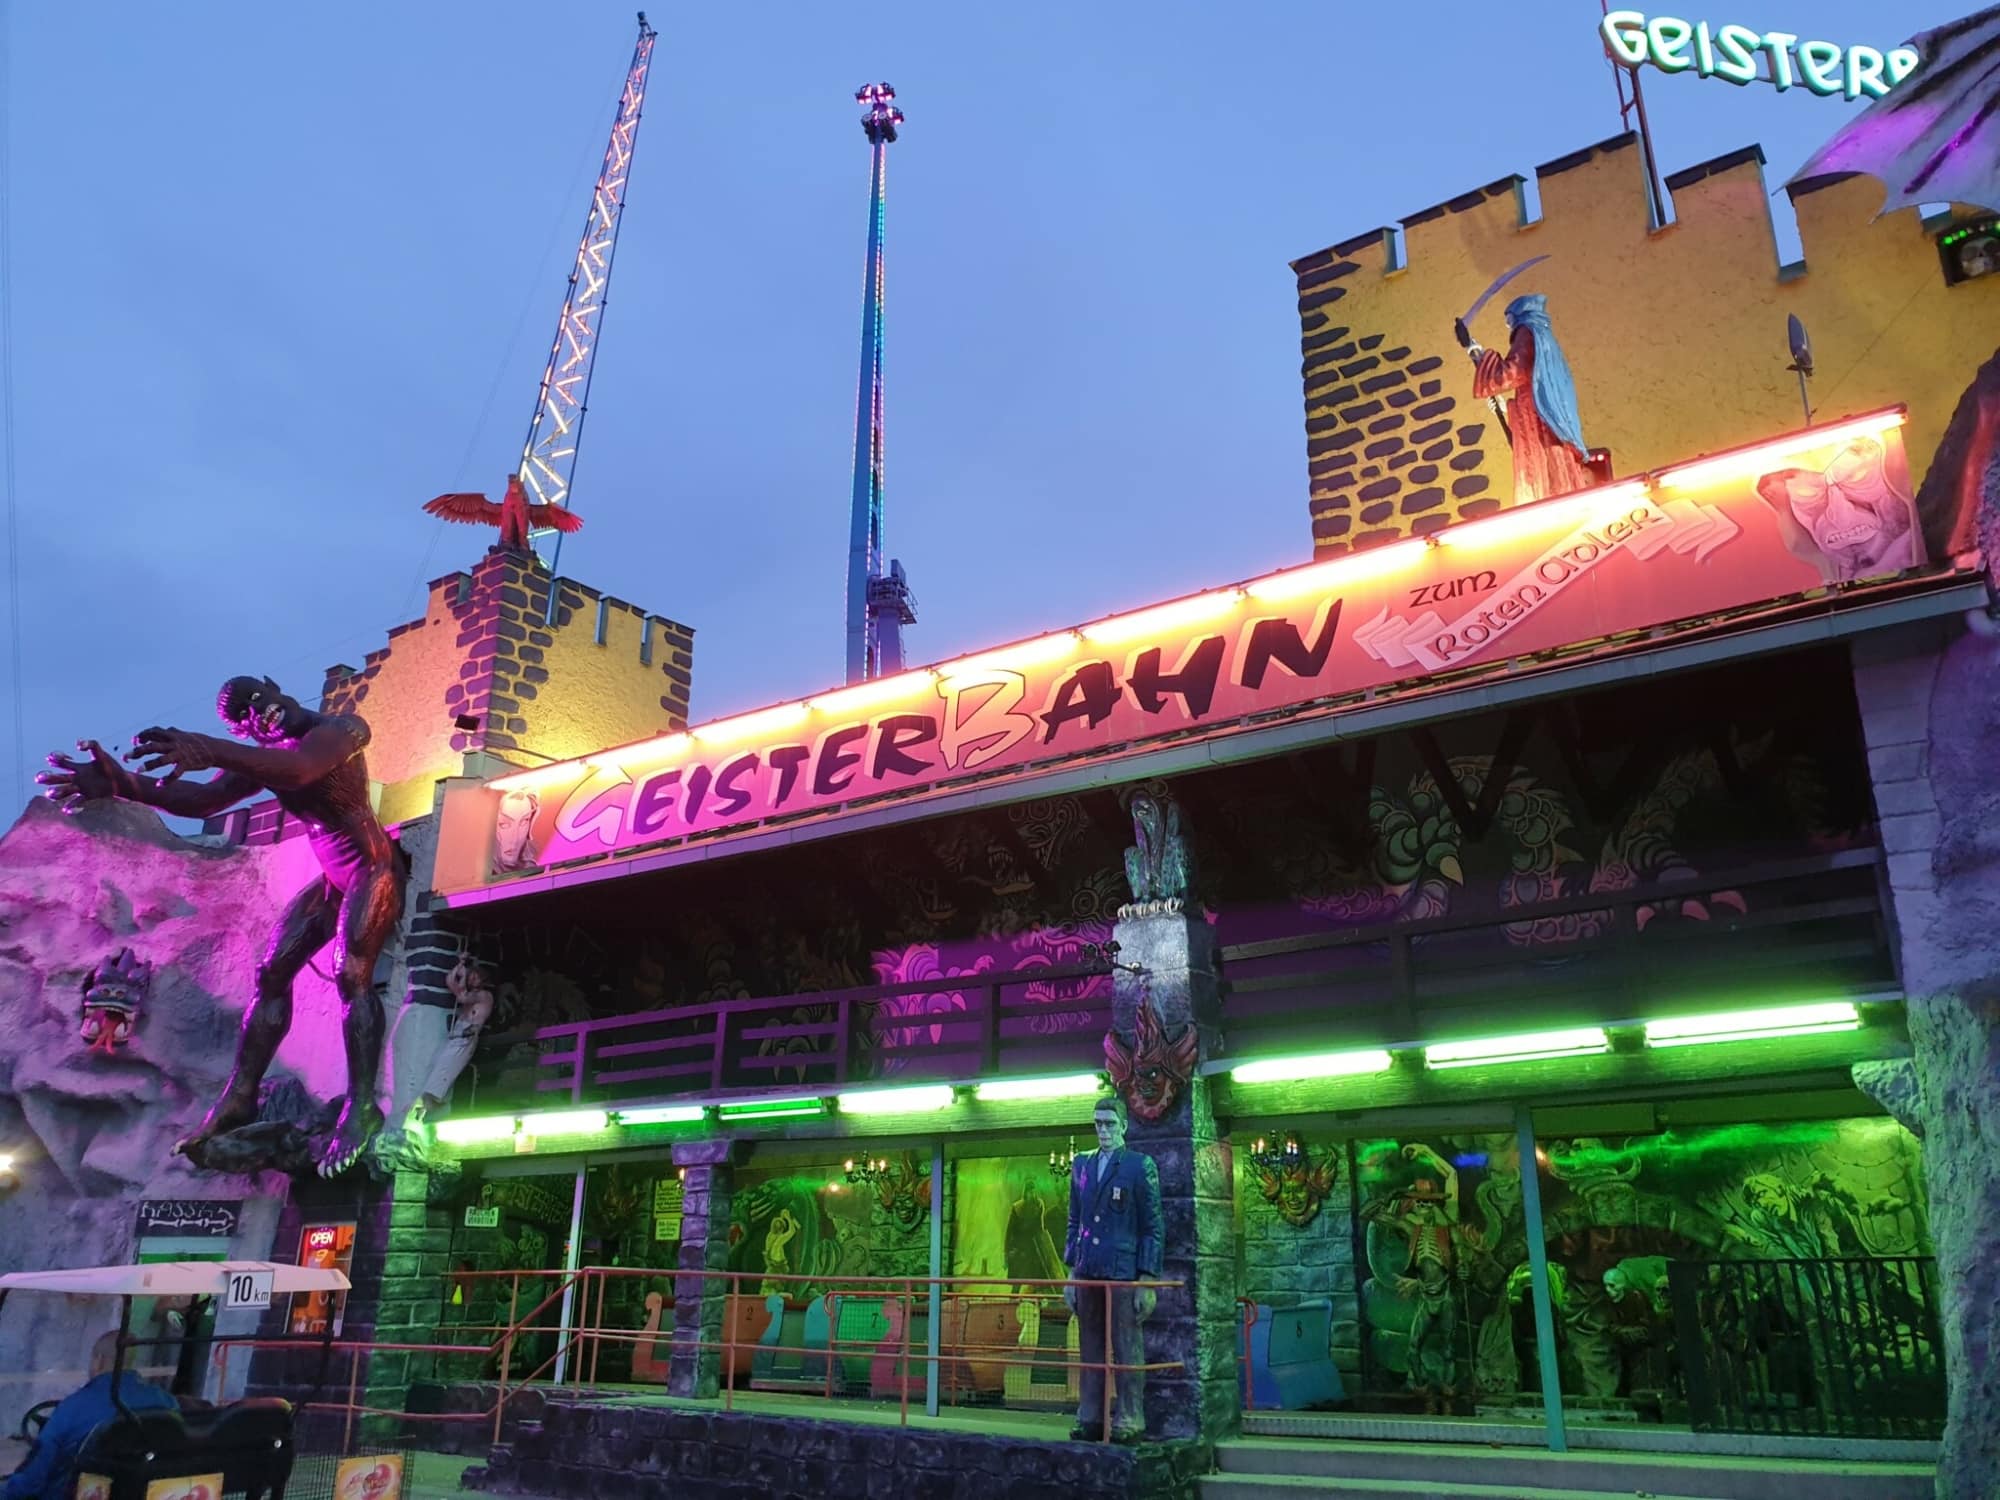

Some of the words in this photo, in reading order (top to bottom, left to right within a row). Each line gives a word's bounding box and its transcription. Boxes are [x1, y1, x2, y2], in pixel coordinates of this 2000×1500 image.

[310, 1231, 334, 1246] OPEN
[231, 1275, 253, 1303] 10
[254, 1288, 270, 1302] km
